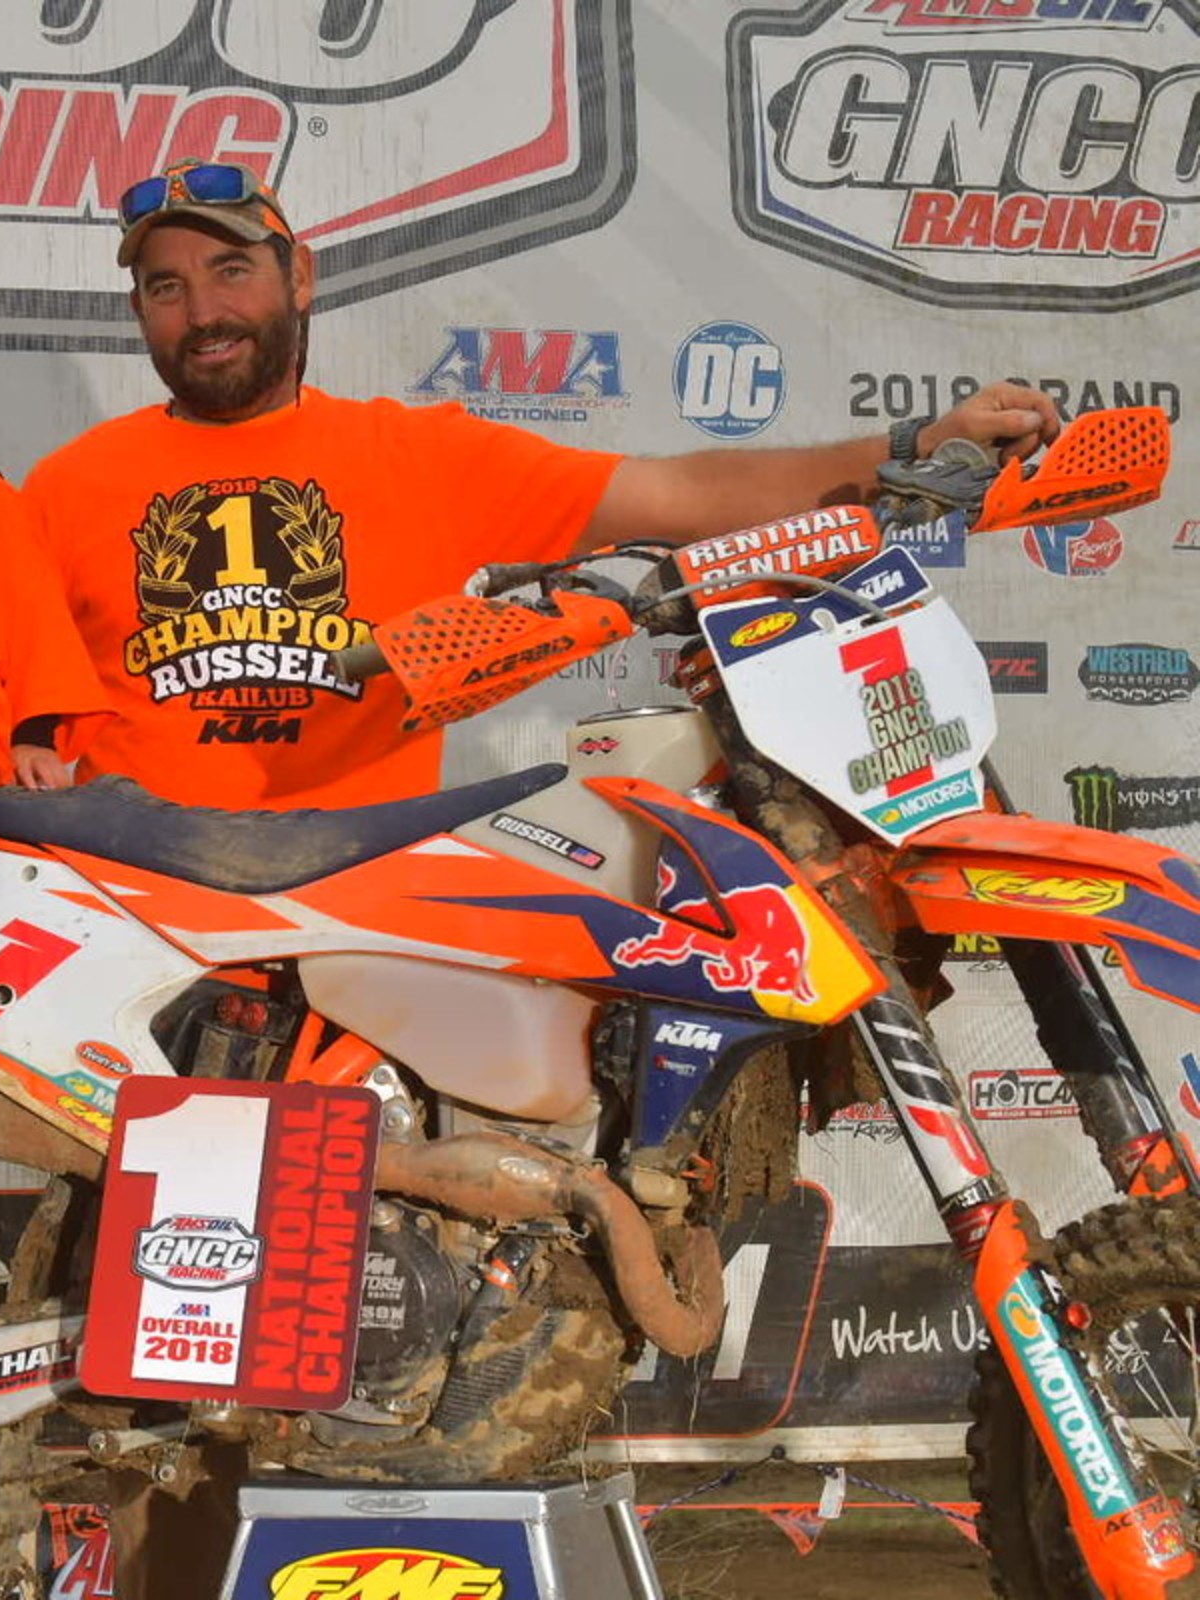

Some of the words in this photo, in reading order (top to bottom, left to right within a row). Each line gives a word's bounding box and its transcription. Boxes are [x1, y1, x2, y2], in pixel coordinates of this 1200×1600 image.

[893, 190, 1168, 257] RACING
[407, 328, 623, 398] AMA
[681, 343, 782, 419] DC
[468, 406, 587, 422] ANCTIONED
[1003, 378, 1181, 425] RAND
[208, 480, 256, 494] 2018
[207, 496, 267, 587] 1
[687, 506, 862, 568] RENTHAL
[698, 530, 873, 596] RENTHAL
[203, 586, 282, 611] GNCC
[855, 566, 906, 601] KTM
[730, 612, 797, 647] FMF
[988, 659, 1039, 677] TIC
[1086, 647, 1191, 675] WESTFIELD
[193, 688, 310, 707] KAILUB
[859, 668, 926, 718] 2018
[197, 711, 301, 744] KTM
[868, 702, 934, 751] GNCC
[848, 718, 971, 797] CHAMPION
[899, 777, 973, 820] MOTOREX
[494, 816, 573, 854] RUSSELL
[975, 874, 1117, 902] FMF
[654, 1021, 723, 1052] KTM
[975, 1078, 1076, 1107] HOTCA
[119, 1094, 271, 1385] 1
[169, 1217, 234, 1231] AMSOIL
[143, 1237, 256, 1270] GNCC
[251, 1097, 327, 1392] NATIONAL
[297, 1098, 371, 1394] CHAMPION
[167, 1265, 228, 1280] RACING
[142, 1317, 238, 1339] OVERALL
[174, 1303, 211, 1317] AMA
[831, 1305, 925, 1360] Watch
[931, 1304, 991, 1352] Us
[143, 1336, 234, 1365] 2018
[1023, 1342, 1132, 1509] MOTOREX
[272, 1559, 503, 1600] FMF
